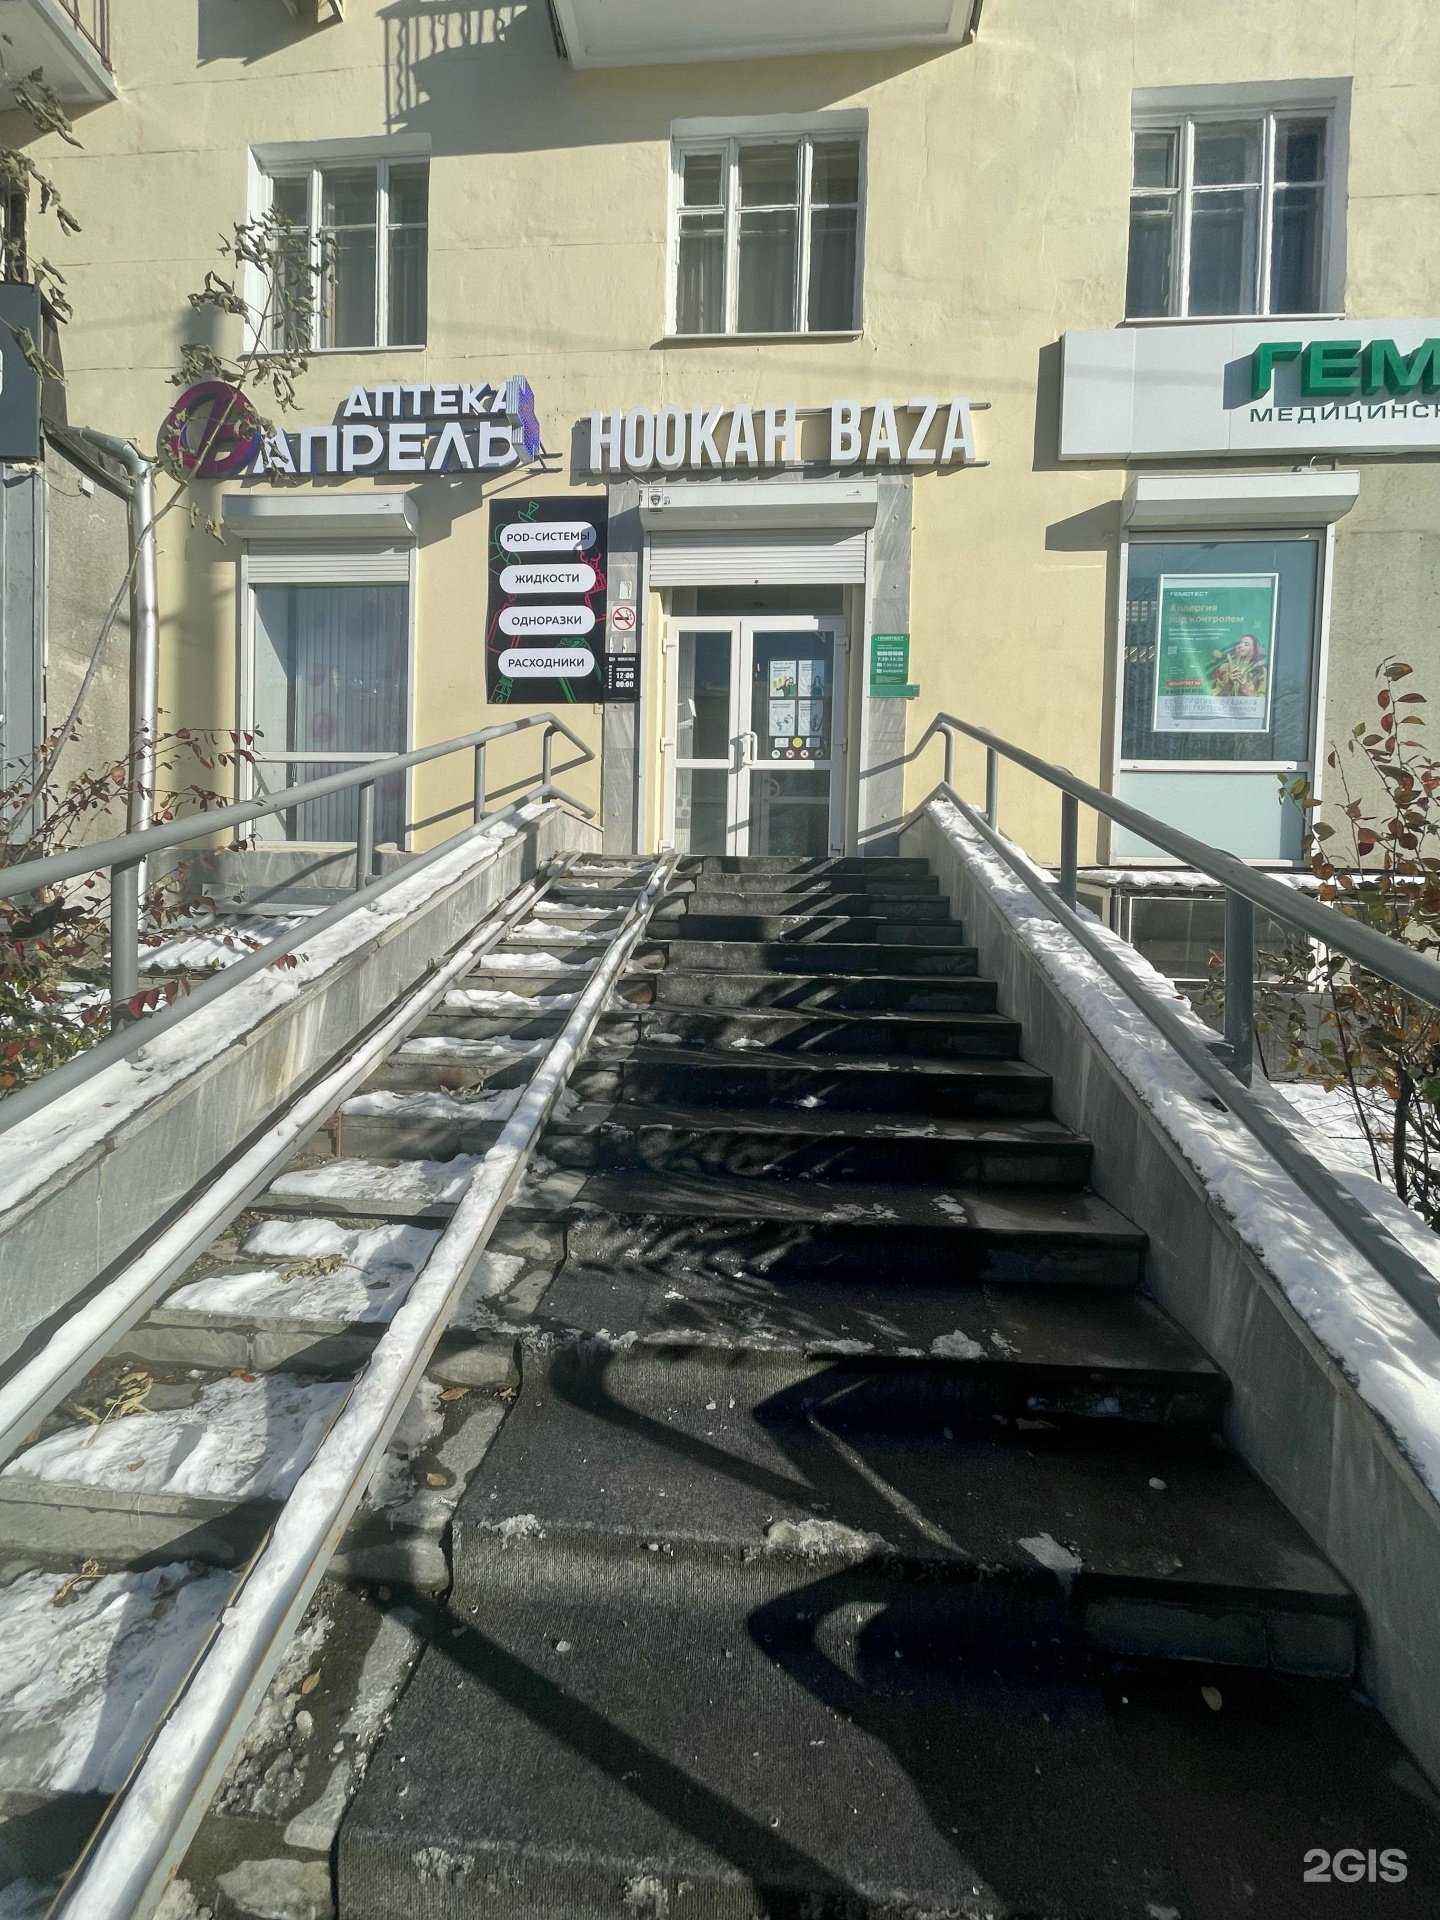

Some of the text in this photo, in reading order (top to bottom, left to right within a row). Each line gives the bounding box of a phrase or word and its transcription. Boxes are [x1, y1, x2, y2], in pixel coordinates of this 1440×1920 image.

[1252, 338, 1440, 397] ГЕМ
[253, 420, 520, 474] АПРЕЛЬ
[590, 396, 978, 474] HOOKAH BAZA
[514, 573, 580, 584] ЖИДКОСТИ
[511, 616, 582, 627] ОДНОРАЗКИ
[508, 658, 584, 669] РАСХОДНИКИ
